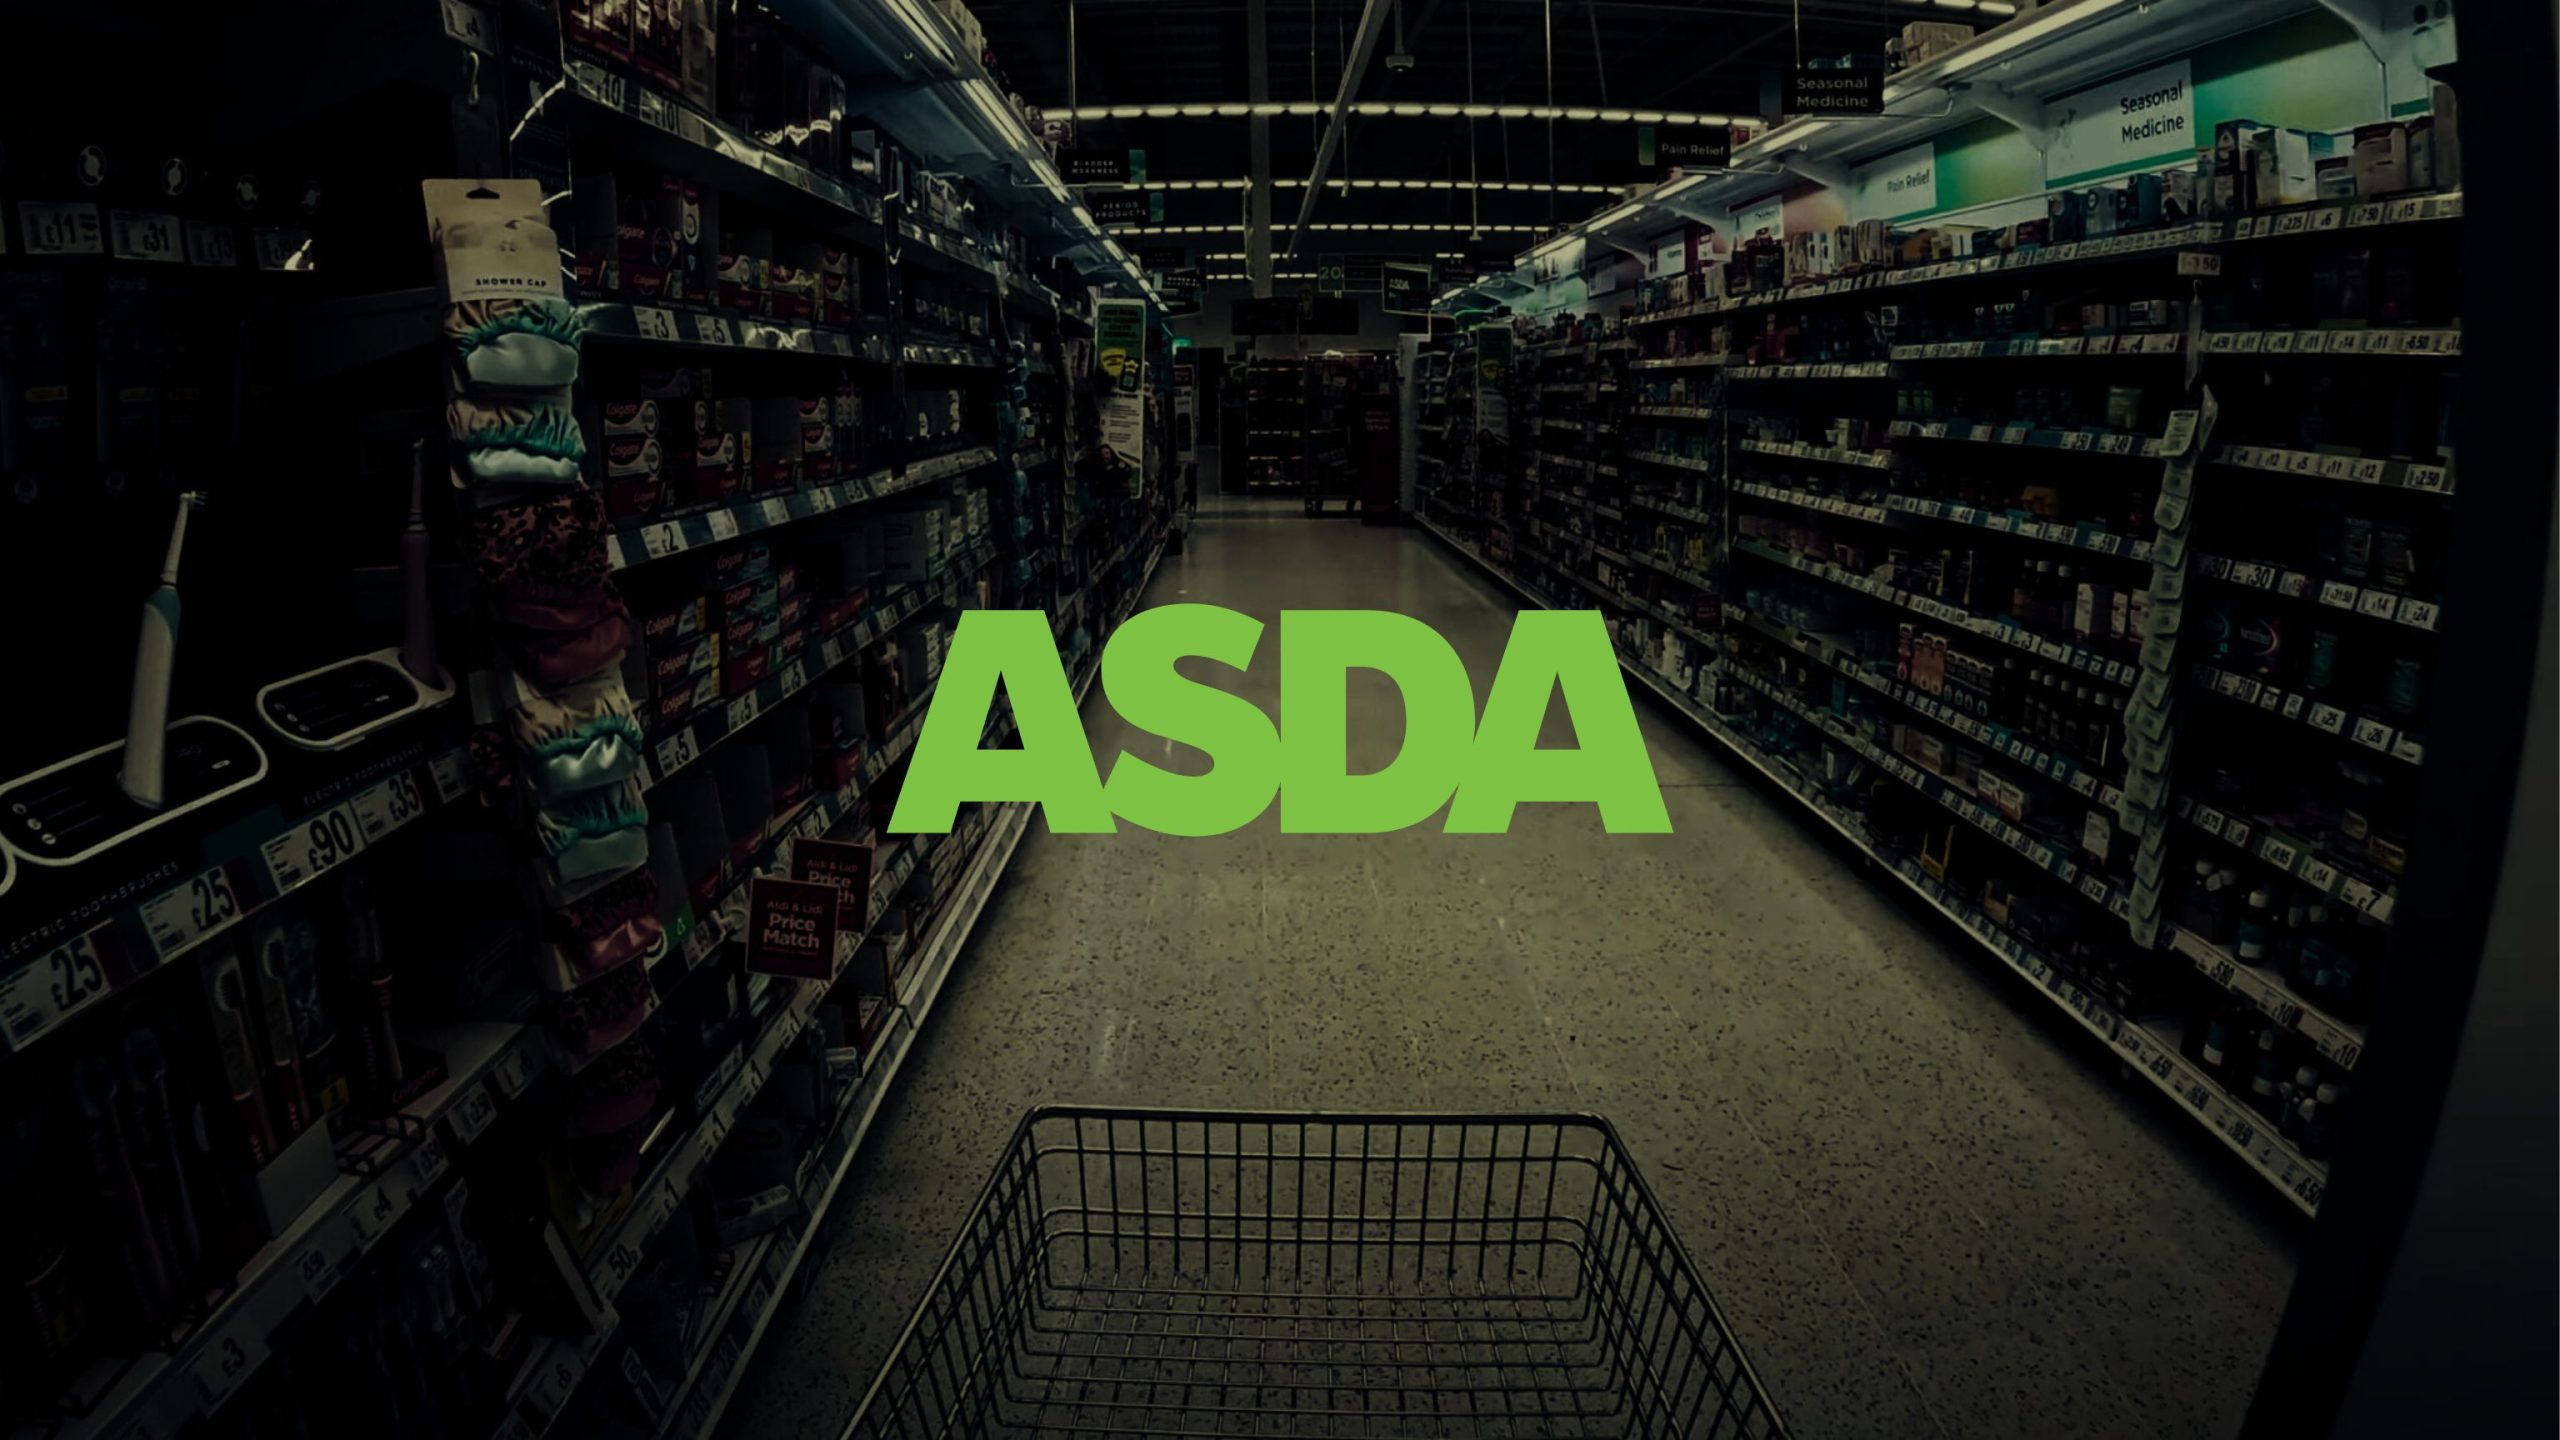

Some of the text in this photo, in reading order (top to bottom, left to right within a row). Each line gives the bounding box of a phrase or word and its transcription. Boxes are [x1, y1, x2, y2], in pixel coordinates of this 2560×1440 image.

[1796, 76, 1868, 90] Seasonal
[1796, 95, 1869, 108] Medicine
[2120, 80, 2183, 115] Seasonal
[2122, 115, 2185, 144] Medicine
[1661, 142, 1725, 156] Pain Relief
[1887, 169, 1931, 193] Pain Relief
[475, 278, 547, 287] SHOWER CAP
[1320, 266, 1341, 280] 20
[308, 810, 355, 872] £90
[808, 870, 852, 888] Price
[70, 860, 180, 920] TOOTHBRUSHES
[192, 868, 235, 931] £25
[767, 900, 789, 911] Aldi
[802, 904, 823, 914] Lidl
[769, 913, 816, 932] Price
[762, 928, 820, 949] Match
[50, 936, 104, 1012] £25
[221, 1337, 246, 1379] £3
